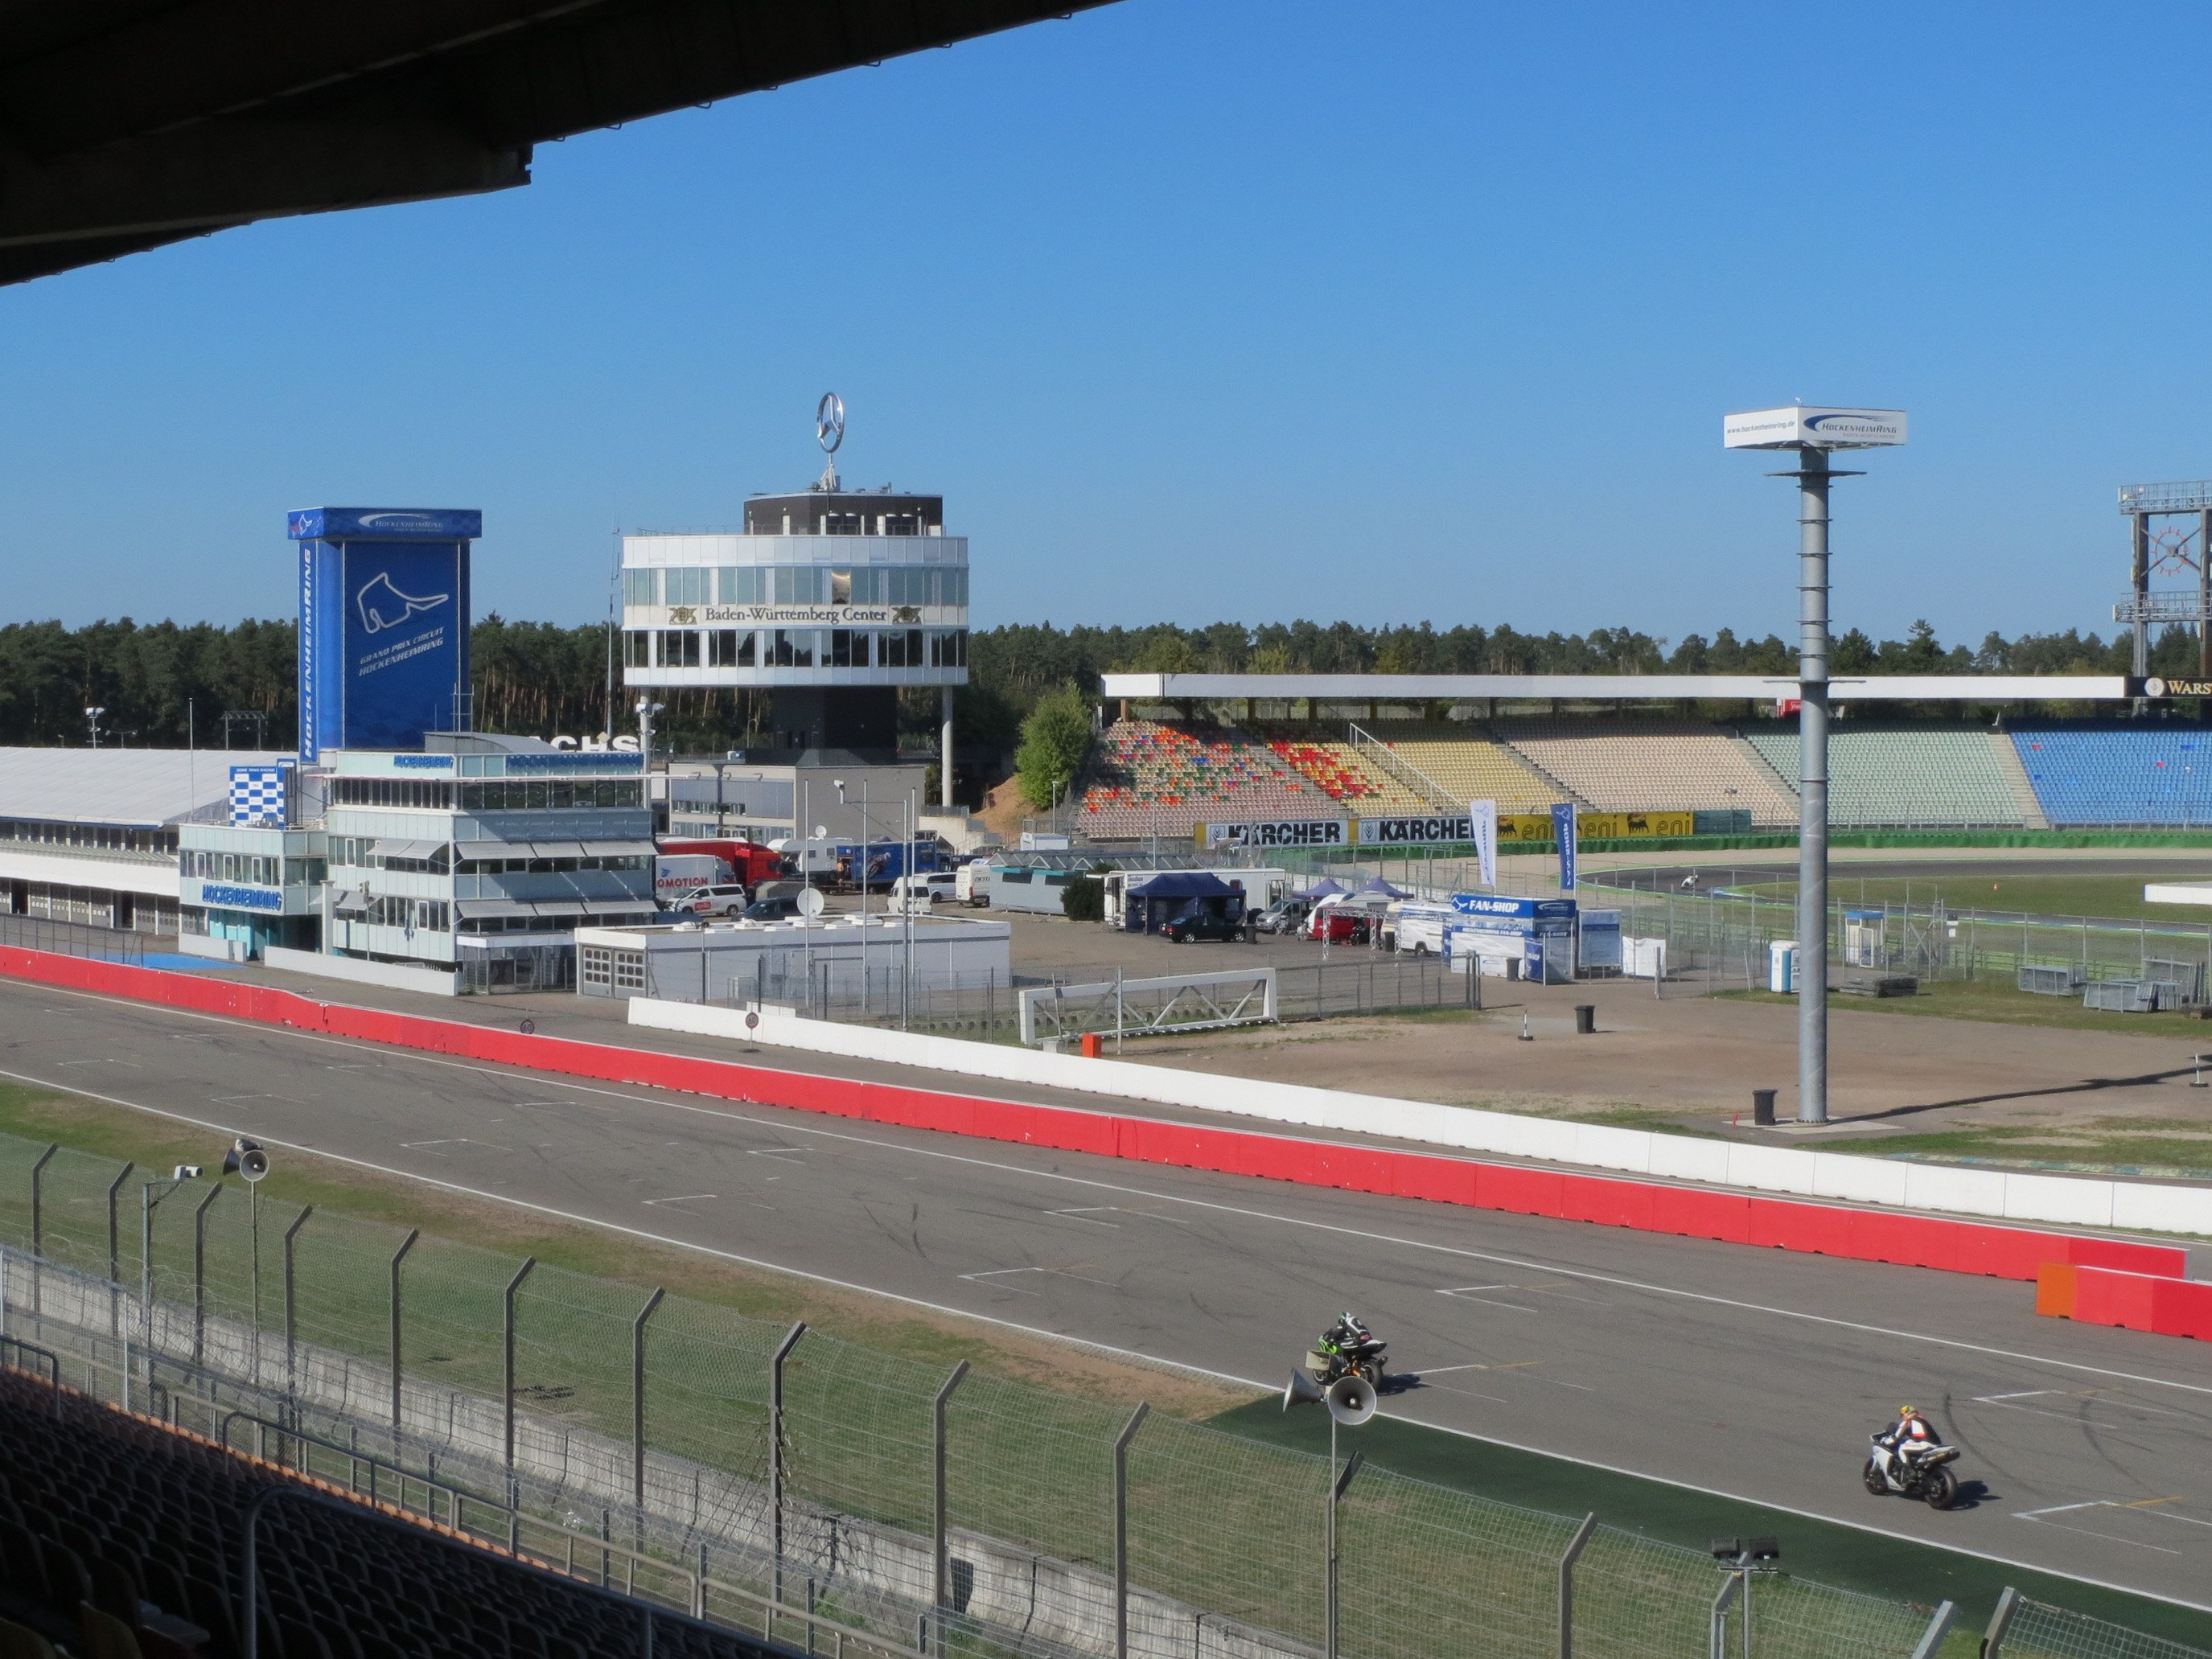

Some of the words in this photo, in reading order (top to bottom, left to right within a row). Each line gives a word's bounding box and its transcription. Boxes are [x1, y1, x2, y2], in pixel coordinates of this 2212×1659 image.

[705, 607, 839, 624] Baden-Württemberg
[842, 607, 887, 621] Center
[359, 637, 444, 676] HOCKENHEIMRING
[360, 647, 390, 665] GRAND
[391, 640, 411, 653] PRIX
[413, 626, 444, 644] CIRCUIT
[1227, 822, 1341, 845] KÄRCHER
[1379, 819, 1475, 841] KÄRCHE
[1584, 815, 1617, 839] eni
[1656, 812, 1690, 837] eni
[1469, 899, 1519, 913] FAN-SHOP
